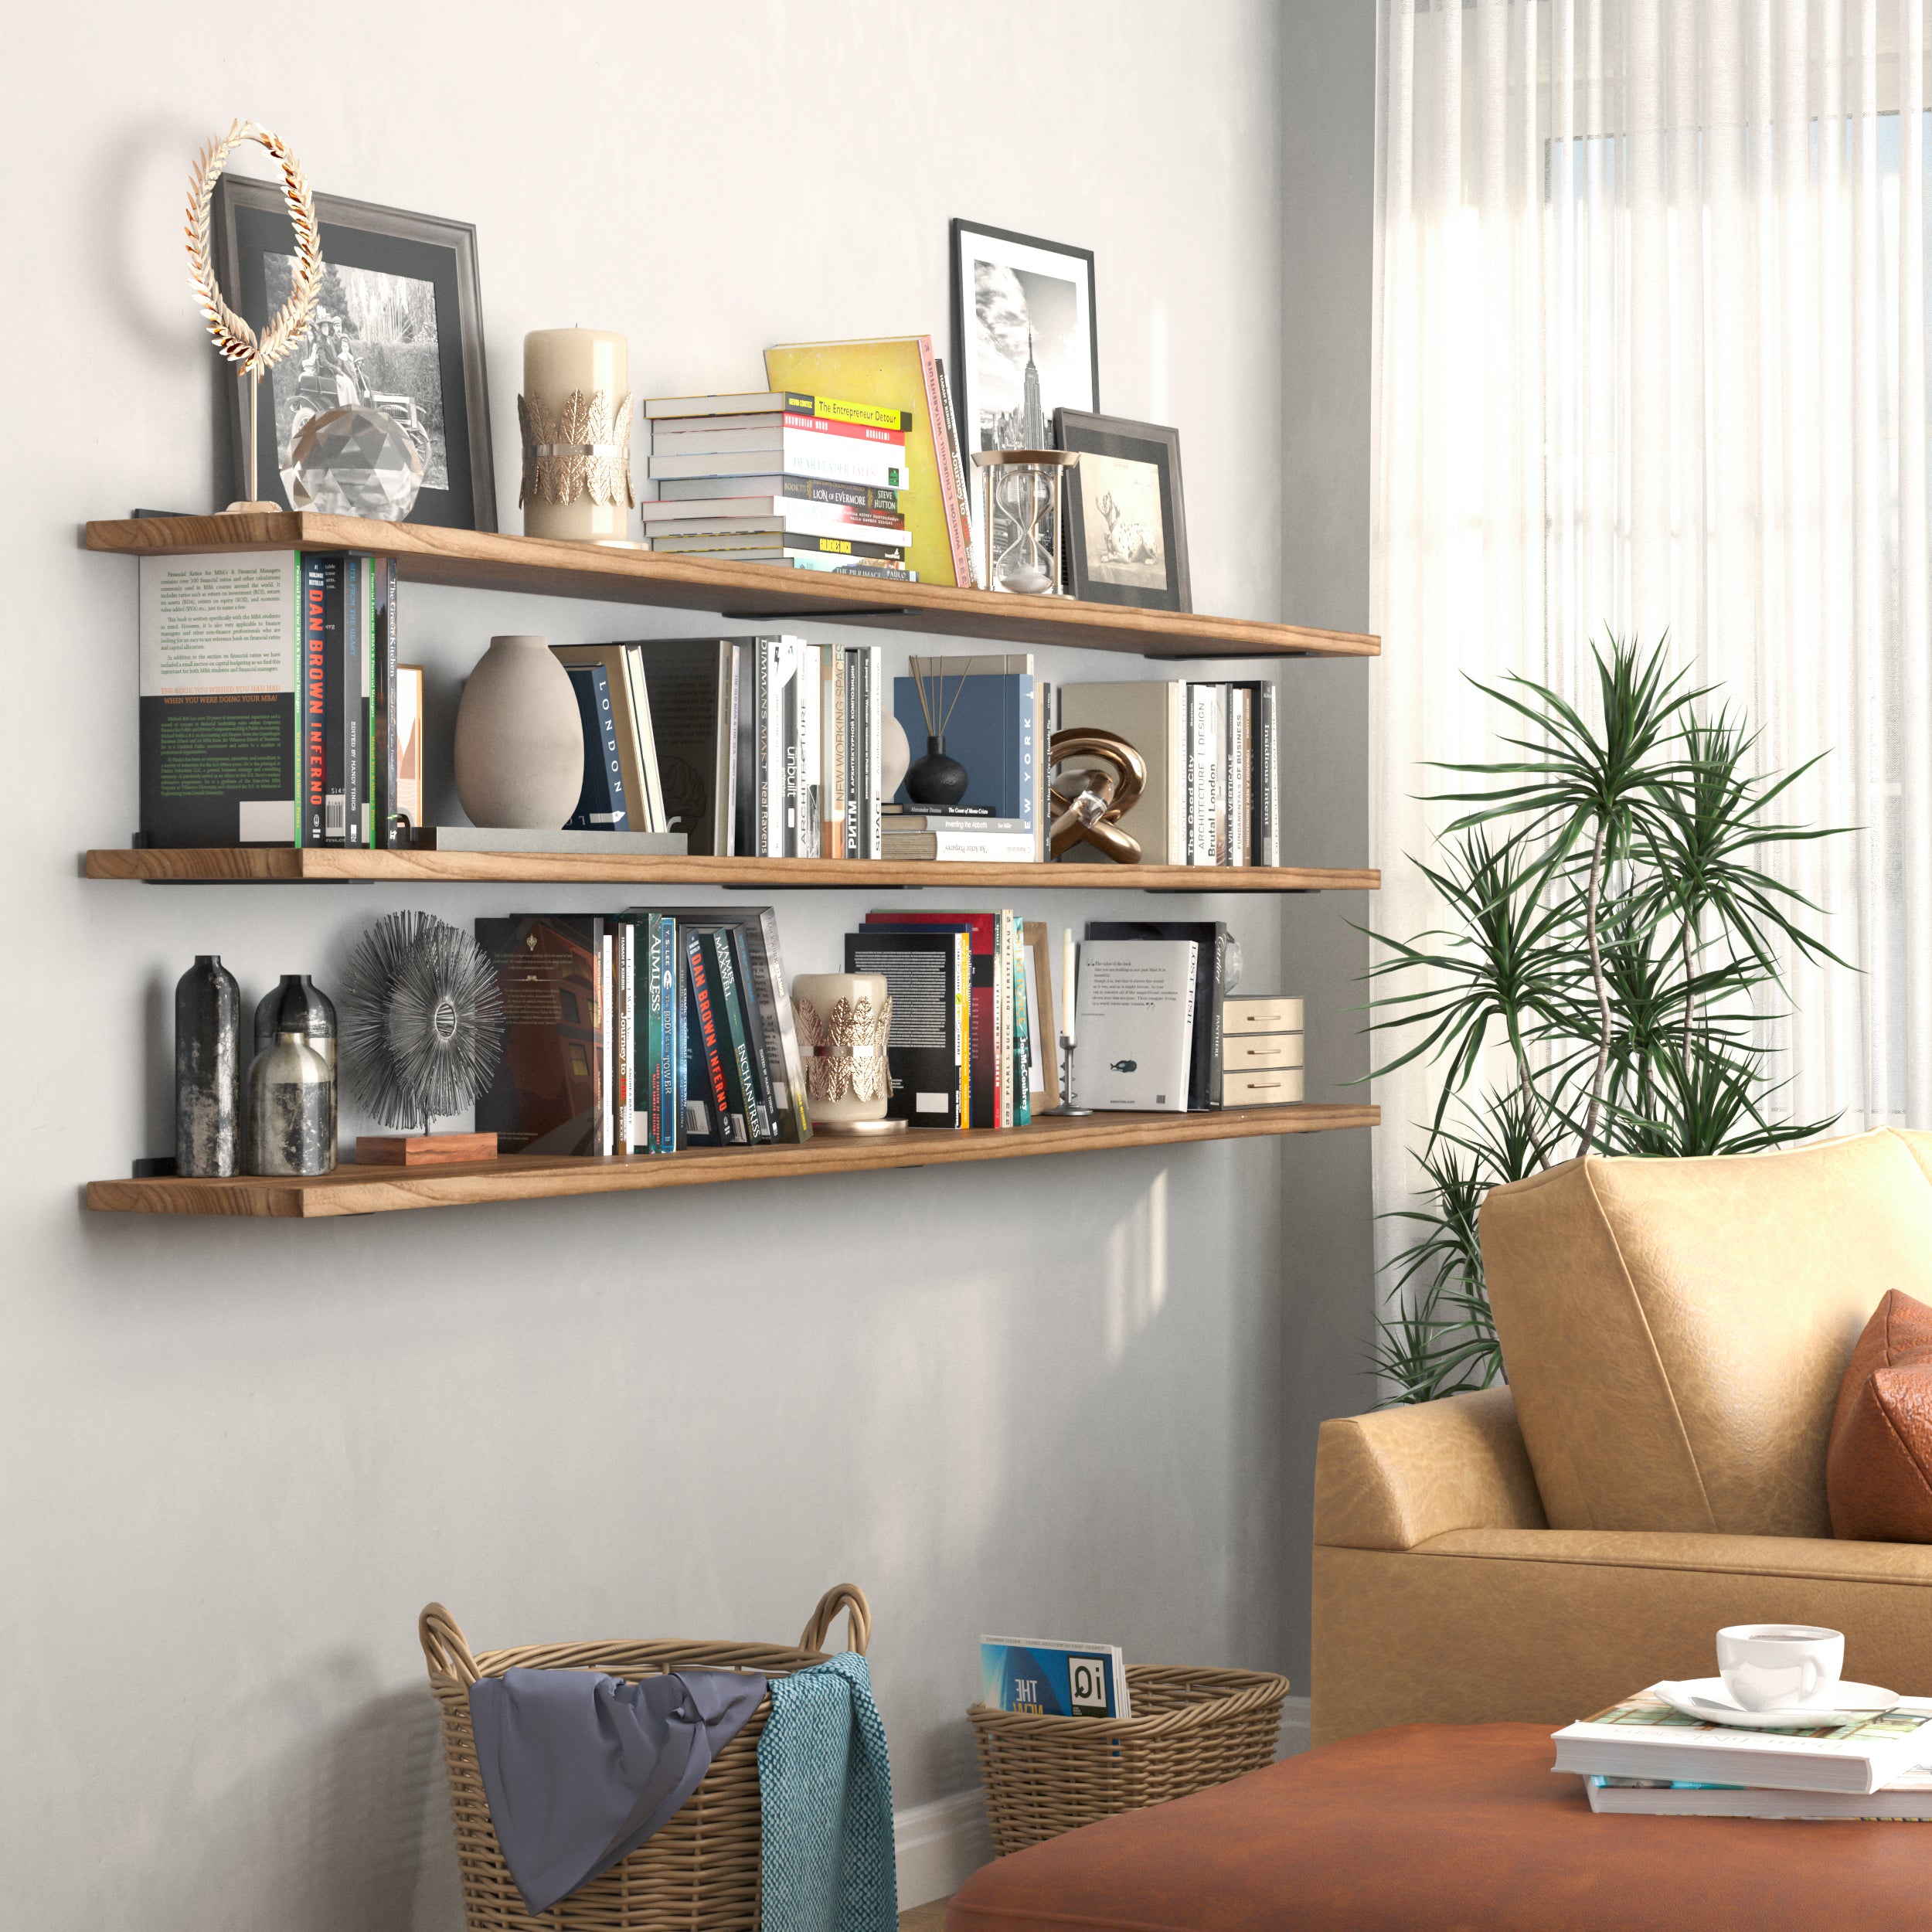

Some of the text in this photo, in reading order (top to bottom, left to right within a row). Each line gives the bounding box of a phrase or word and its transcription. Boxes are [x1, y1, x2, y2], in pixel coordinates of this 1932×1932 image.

[785, 416, 889, 440] NORWEGIAN WOOD MURAKAMI
[819, 401, 896, 423] The Entrepreneur Detour
[927, 360, 961, 550] WINSTON CHURCHILL WELTABENTEUER
[784, 483, 799, 492] BOOK
[813, 489, 866, 505] LION EVERMORE
[875, 490, 896, 510] STEVE HUTTON
[951, 452, 965, 515] Journey to
[886, 570, 906, 579] PAULO
[309, 589, 323, 805] DAN BROWN INFERNO
[599, 681, 622, 792] LONDON
[787, 747, 797, 798] unbuilt
[1236, 767, 1241, 781] OF
[946, 821, 964, 829] Inventing
[1229, 846, 1233, 860] LA
[651, 934, 662, 1012] AIMLESS
[691, 953, 706, 987] DAN
[715, 937, 734, 1000] JAMES MAXWELL
[767, 918, 785, 998] CLOCKWORK STRANGE
[1216, 936, 1226, 985] Cartier
[664, 1011, 672, 1034] BODY
[698, 989, 716, 1047] BROWN
[1016, 978, 1026, 1026] FORCE
[621, 1063, 627, 1075] to
[663, 1055, 672, 1094] TOWER
[709, 1049, 727, 1111] INFERNO
[738, 1043, 761, 1138] ENCHANTRESS
